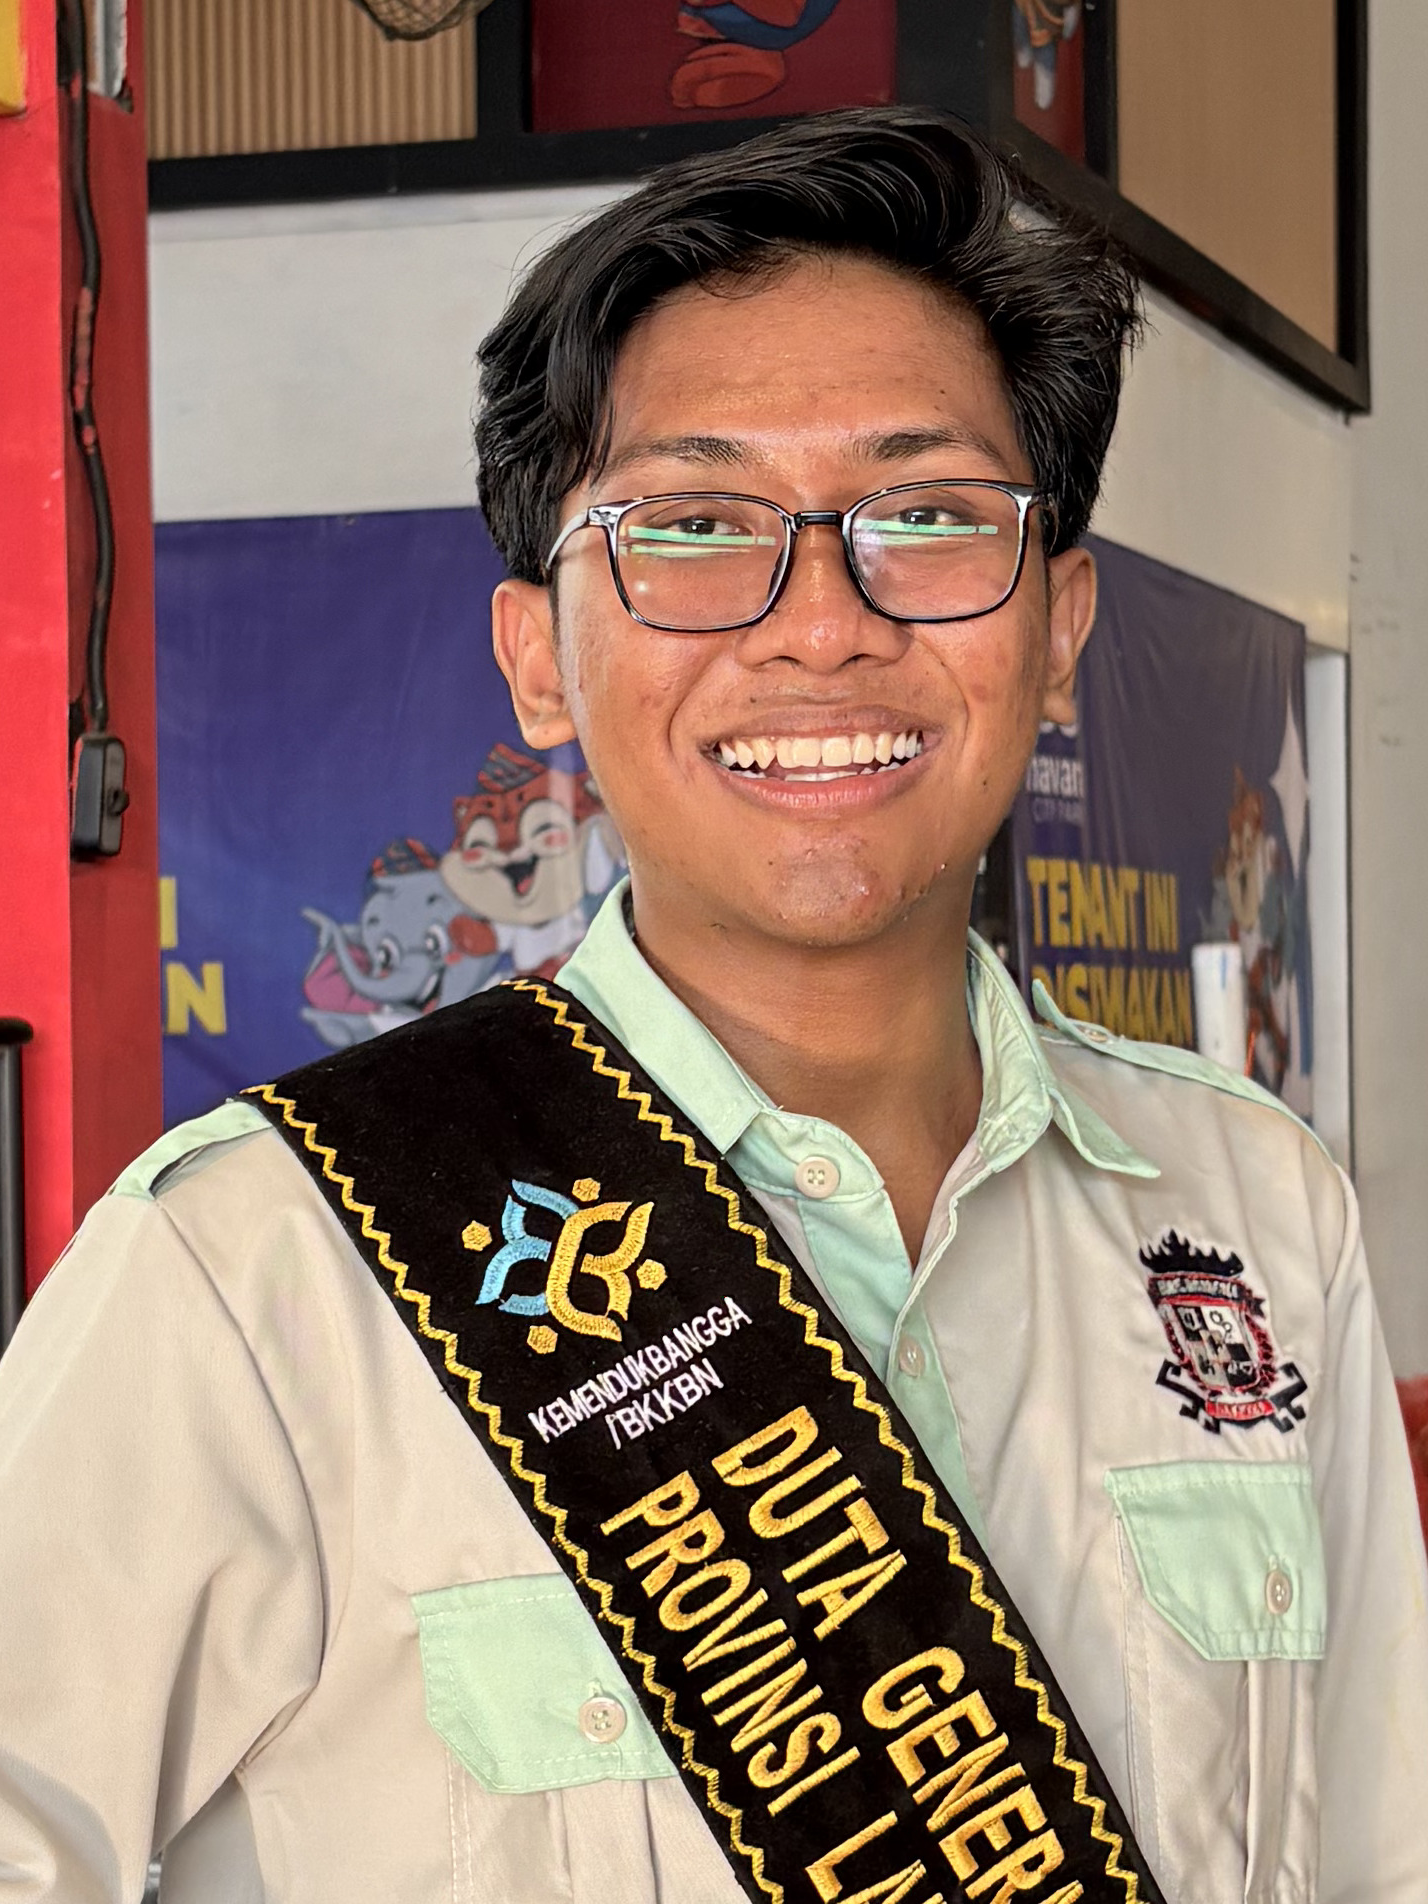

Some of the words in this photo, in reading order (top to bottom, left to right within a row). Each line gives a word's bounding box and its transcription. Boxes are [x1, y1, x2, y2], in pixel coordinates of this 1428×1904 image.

[528, 1296, 753, 1443] KEMENDUKBANGGA
[712, 1406, 906, 1641] DUTA
[600, 1472, 861, 1817] PROVINSI
